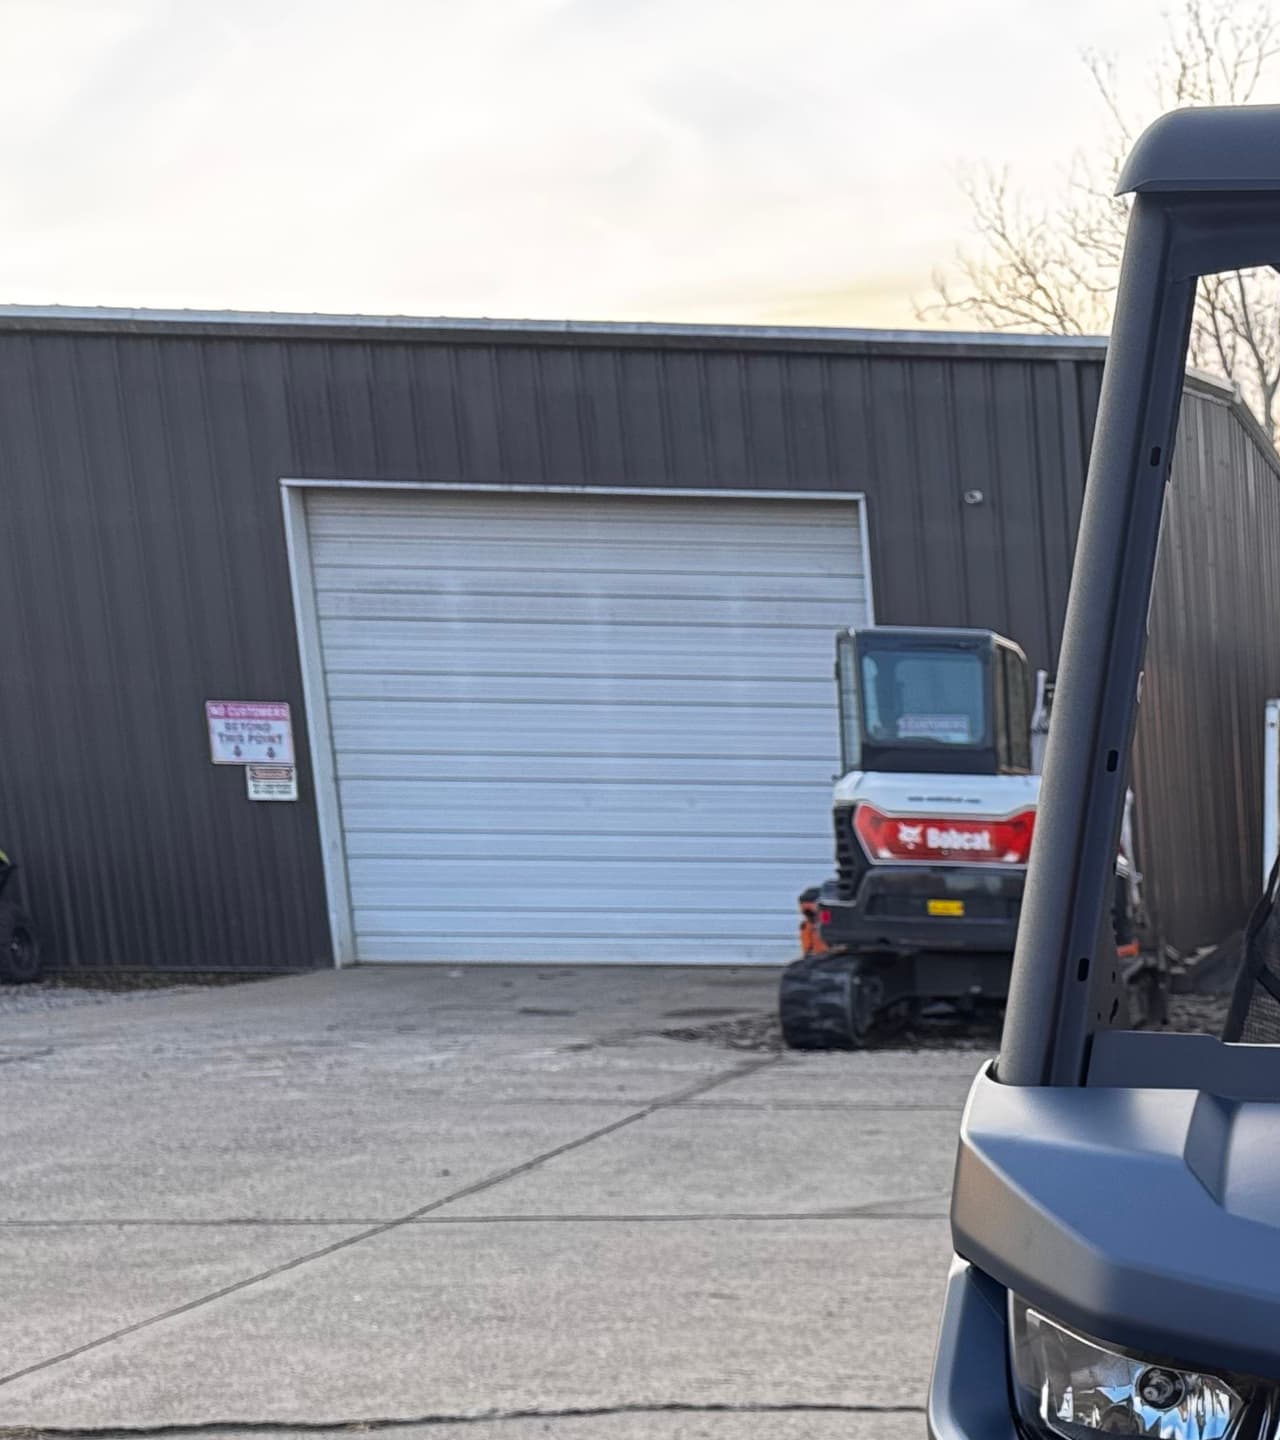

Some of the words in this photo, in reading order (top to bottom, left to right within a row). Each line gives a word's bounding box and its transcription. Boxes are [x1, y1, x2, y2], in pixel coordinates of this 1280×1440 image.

[218, 732, 245, 744] THIS
[247, 733, 283, 745] POINT
[926, 826, 991, 850] Bobcat
